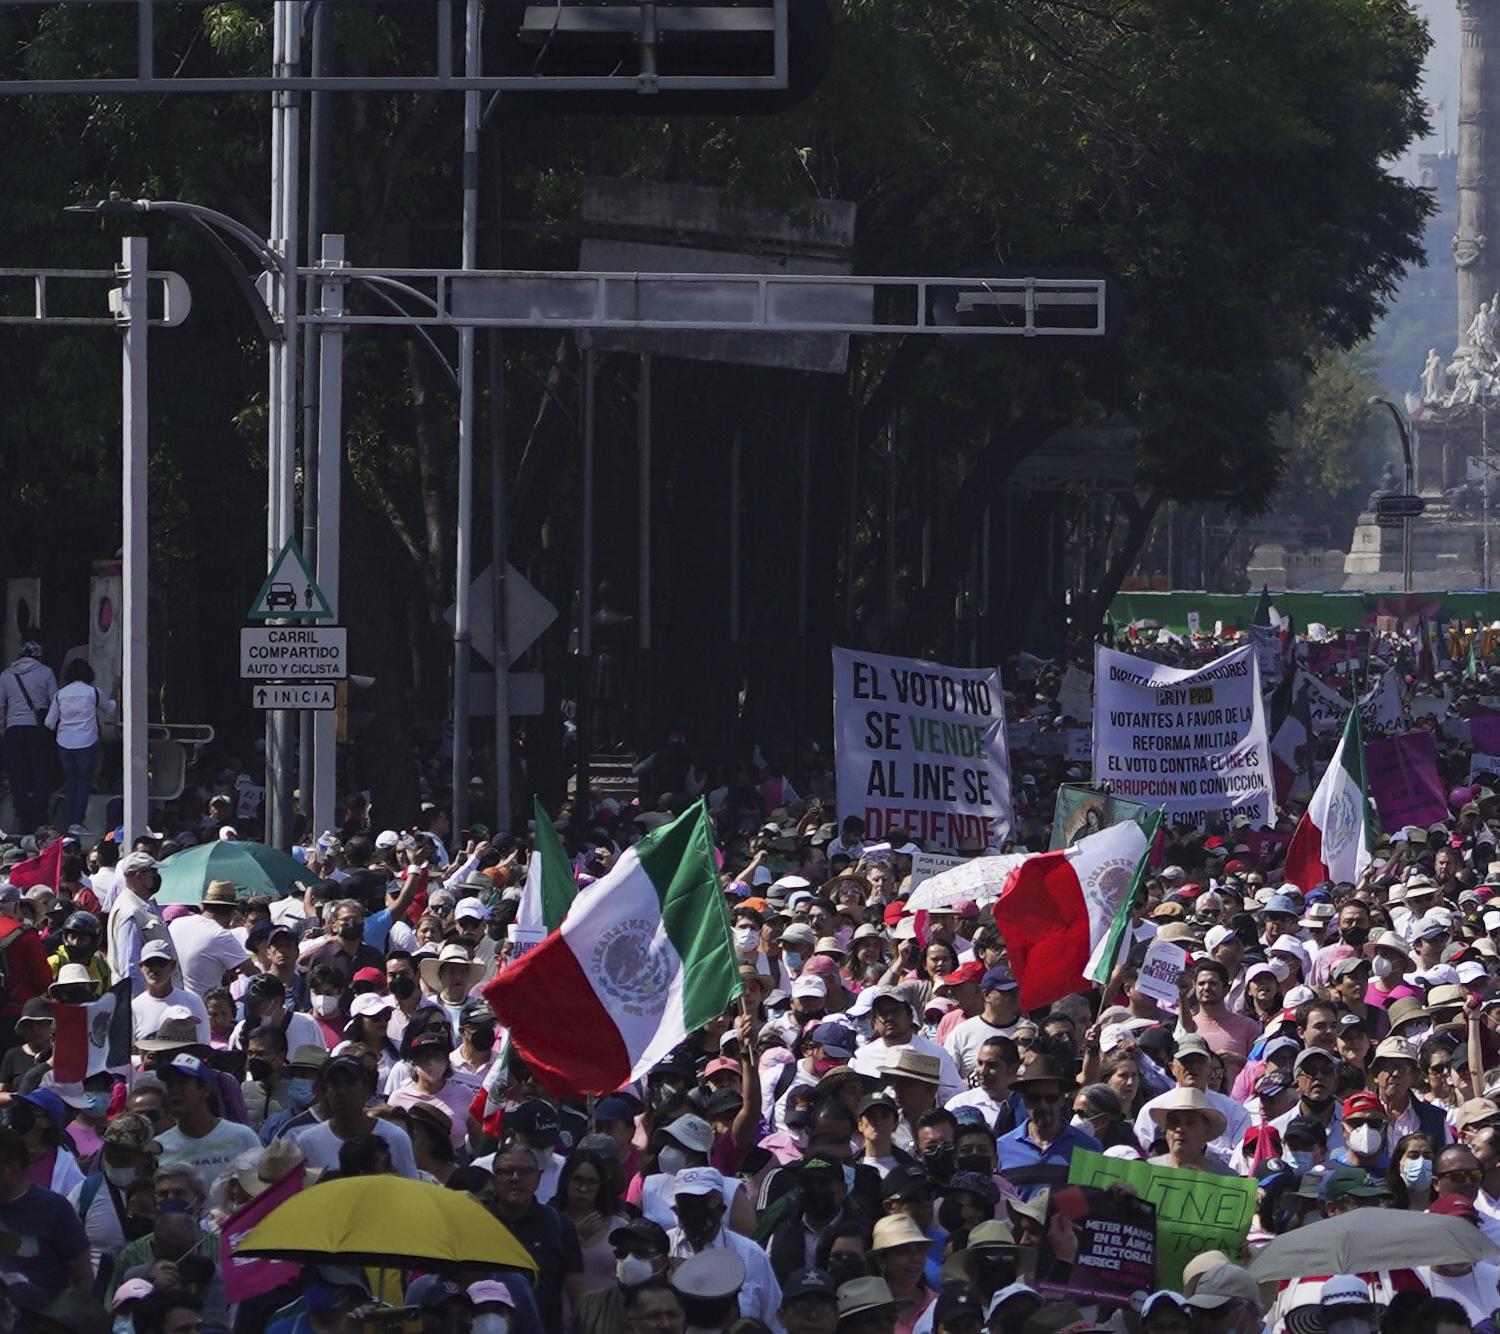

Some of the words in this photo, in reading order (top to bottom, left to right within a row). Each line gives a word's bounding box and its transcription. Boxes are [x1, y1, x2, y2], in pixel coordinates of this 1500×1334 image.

[268, 631, 318, 643] CARRIL
[248, 646, 340, 658] COMPARTIDO
[246, 664, 278, 674] AUTO
[280, 664, 288, 674] Y
[291, 664, 340, 674] CICLISTA
[274, 691, 331, 703] INICIA
[853, 662, 887, 701] EL
[891, 668, 956, 712] VOTO
[961, 679, 992, 716] NO
[1189, 687, 1214, 706] PRD
[1110, 711, 1173, 729] VOTANTES
[1175, 712, 1185, 728] A
[1187, 710, 1223, 728] FAVOR
[1225, 708, 1239, 724] DE
[1240, 706, 1251, 722] LA
[865, 711, 902, 750] SE
[909, 715, 989, 760] VENDE
[1132, 734, 1191, 752] REFORMA
[1193, 730, 1238, 750] MILITAR
[1108, 755, 1122, 771] EL
[1125, 757, 1157, 773] VOTO
[1160, 756, 1208, 774] CONTRA
[1210, 754, 1223, 770] EL
[1246, 750, 1259, 767] ES
[866, 760, 905, 798] AL
[913, 763, 958, 802] INE
[962, 768, 993, 806] SE
[1179, 779, 1197, 796] NO
[1156, 1183, 1241, 1226] INE
[1085, 1219, 1121, 1233] METER
[1122, 1225, 1154, 1242] MANO
[1093, 1233, 1109, 1244] EN
[1110, 1235, 1123, 1245] EL
[1078, 1254, 1121, 1271] MERECE
[1091, 1245, 1153, 1265] ELECTORAL
